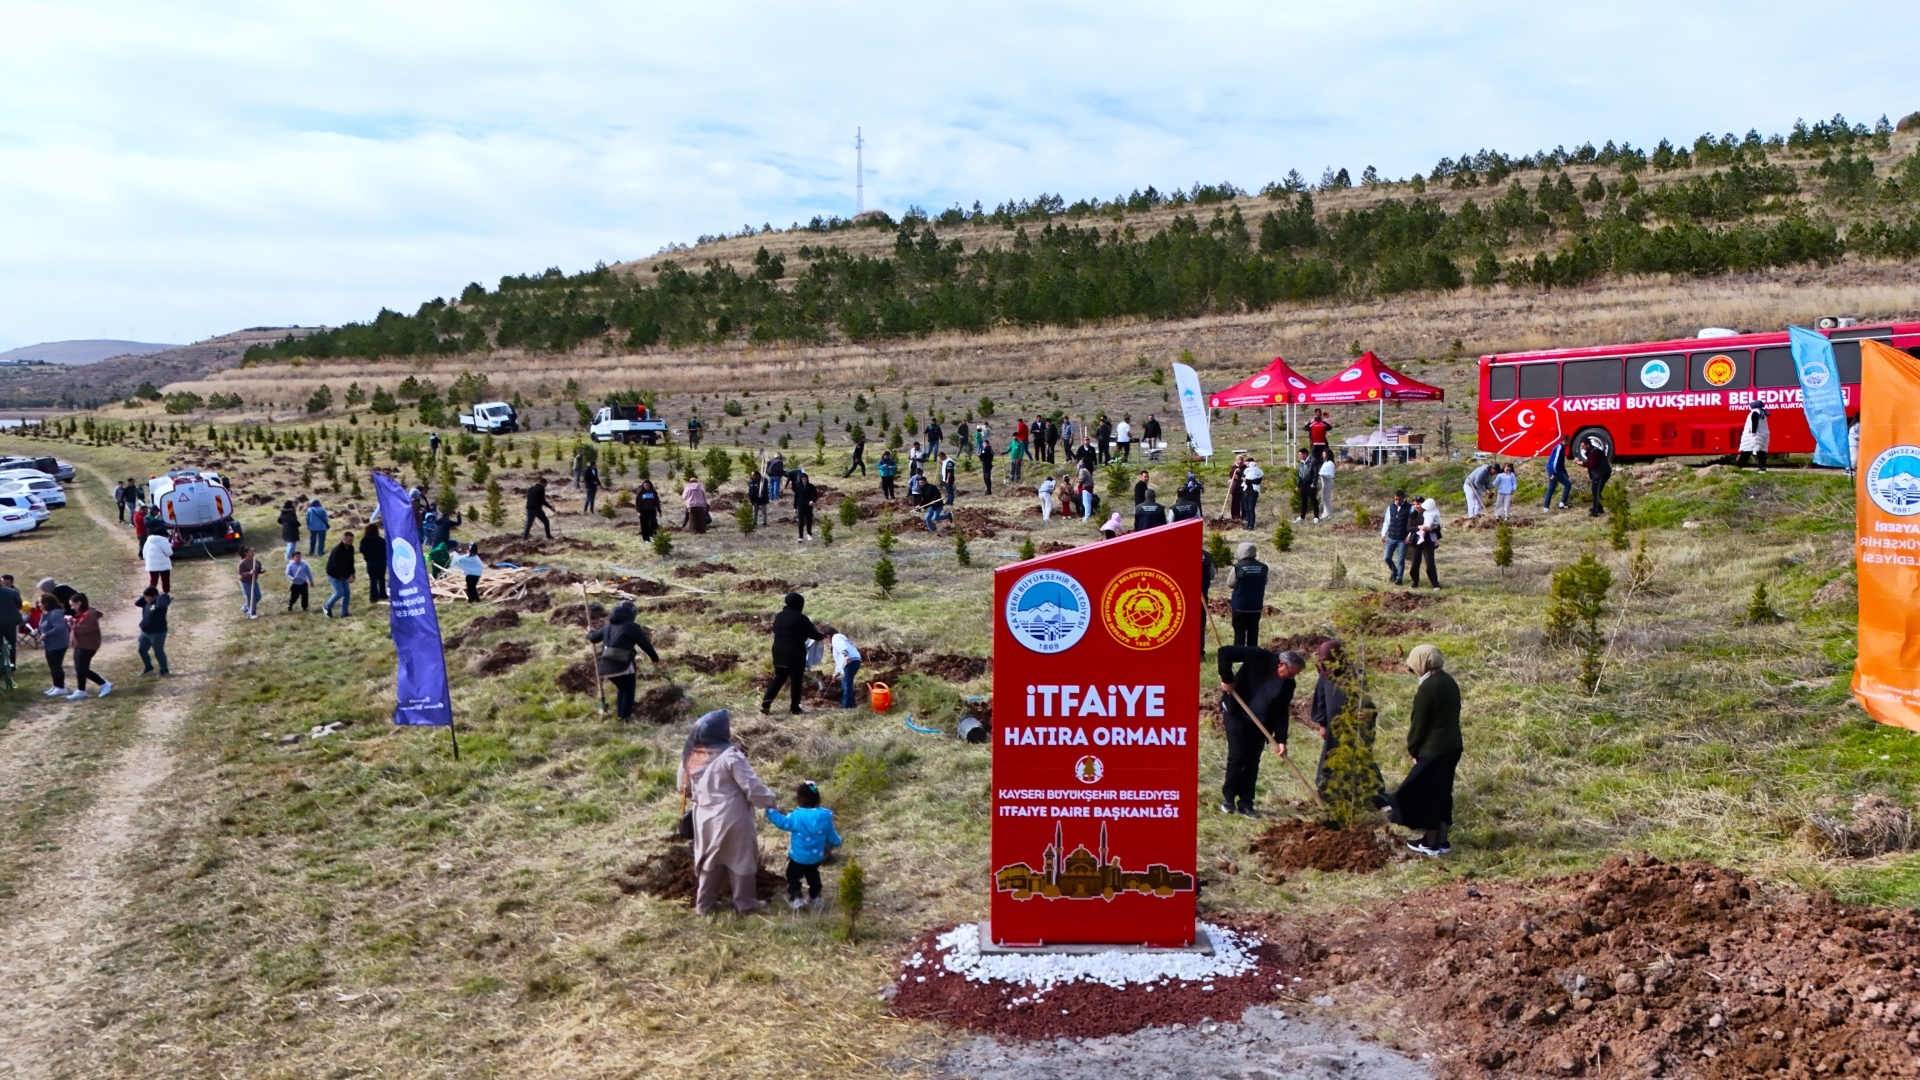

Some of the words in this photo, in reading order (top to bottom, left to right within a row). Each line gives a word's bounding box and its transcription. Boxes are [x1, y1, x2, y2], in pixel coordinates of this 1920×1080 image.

[1626, 393, 1722, 410] BÜYÜKŞEHİR
[1729, 389, 1803, 405] BELEDİYE
[1010, 592, 1020, 630] KAYSERİ
[1018, 573, 1070, 592] BÜYÜKŞEHİR
[1070, 583, 1088, 630] BELEDİYESİ
[1039, 642, 1059, 650] 1869
[1027, 685, 1165, 717] İTFAİYE
[1004, 727, 1089, 746] HATIRA
[1093, 727, 1187, 746] ORMANI
[999, 789, 1045, 800] KAYSERİ
[1046, 789, 1118, 802] BÜYÜKŞEHİR
[1119, 789, 1180, 801] BELEDİYESİ
[999, 806, 1047, 817] İTFAİYE
[1050, 806, 1090, 817] DAİRE
[1093, 804, 1179, 821] BAŞKANLIĞI
